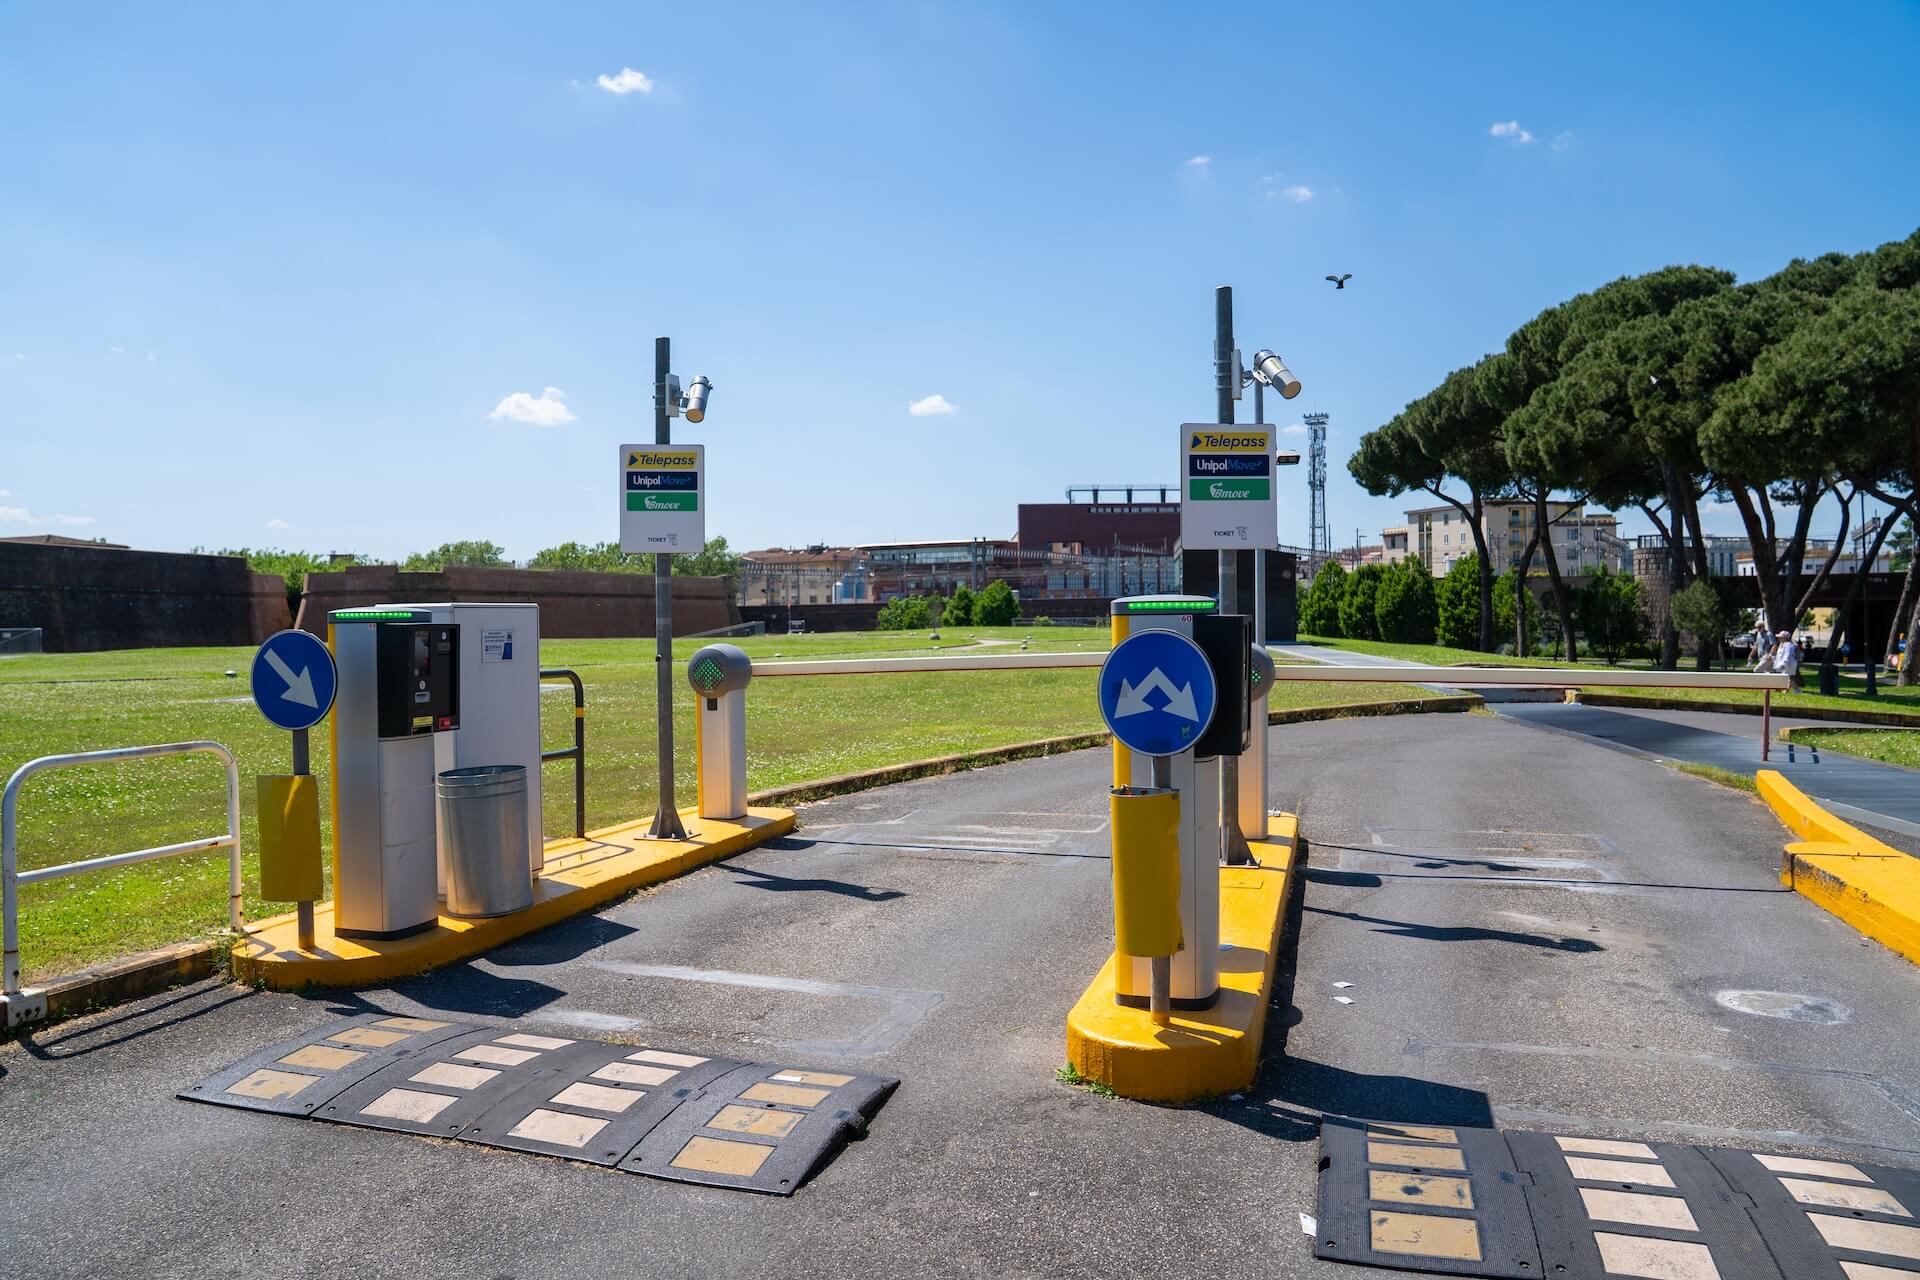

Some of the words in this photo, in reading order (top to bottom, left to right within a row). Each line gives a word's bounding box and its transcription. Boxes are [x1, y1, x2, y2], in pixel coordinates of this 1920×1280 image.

[1204, 435, 1265, 450] Telepass
[640, 454, 694, 467] Telepass
[1196, 459, 1257, 473] UnipolMove
